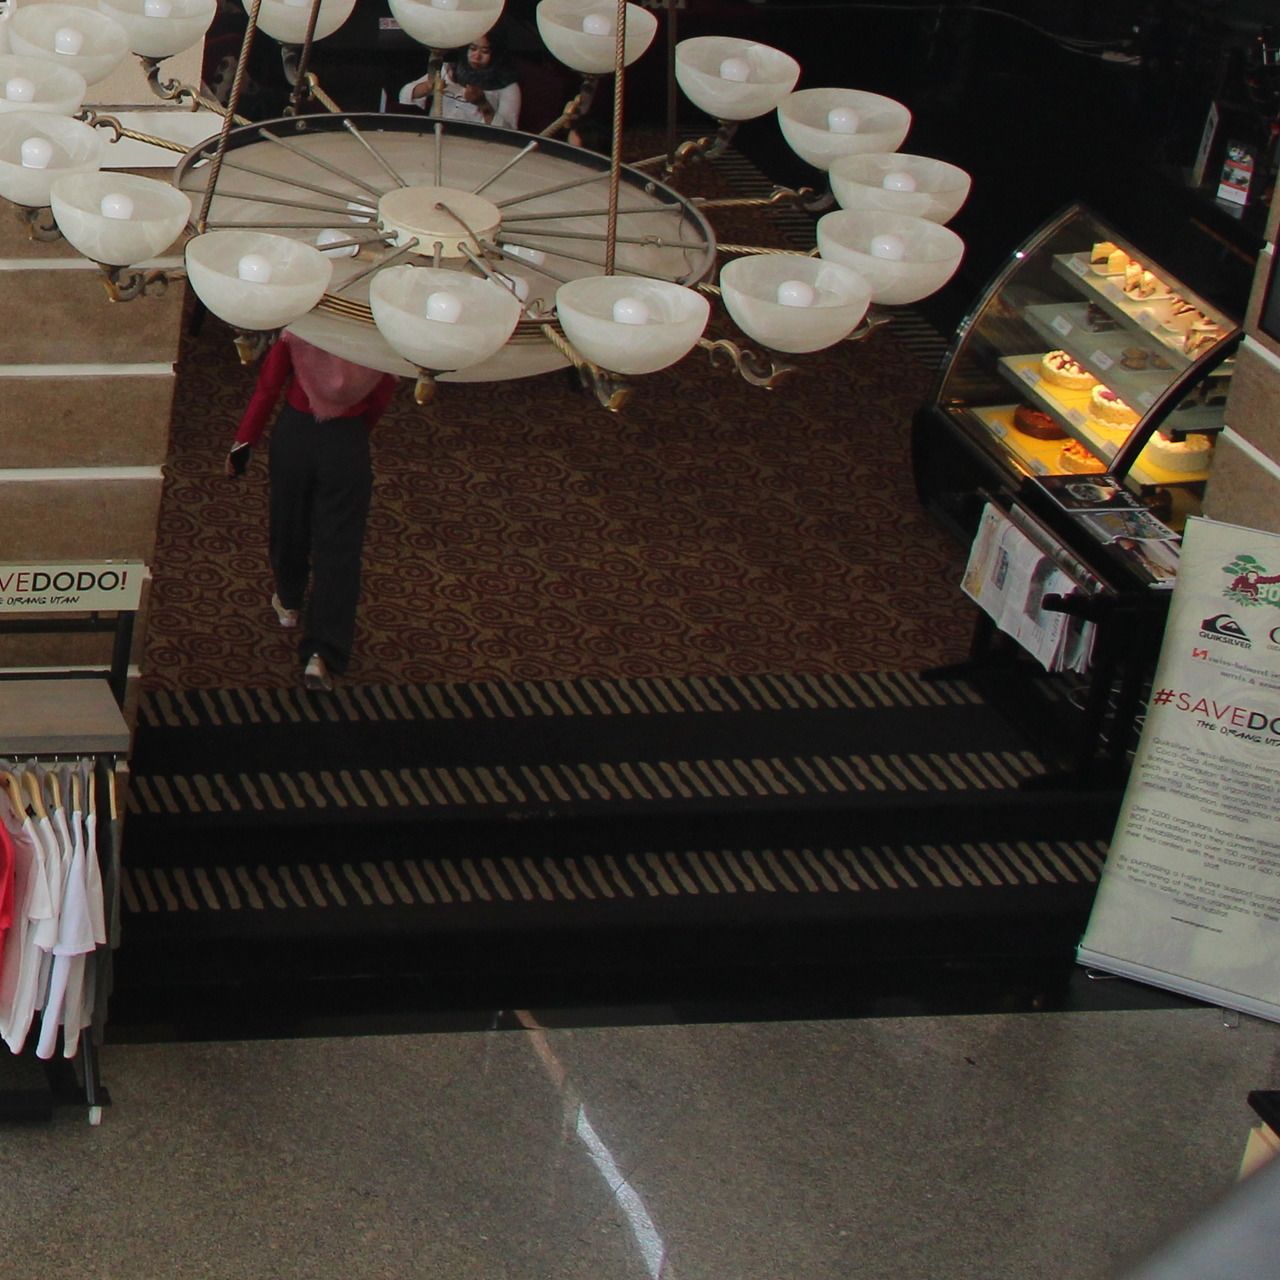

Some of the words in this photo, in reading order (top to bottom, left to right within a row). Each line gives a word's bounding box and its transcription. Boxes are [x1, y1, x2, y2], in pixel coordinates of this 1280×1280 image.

[7, 597, 46, 606] ORANG
[50, 596, 80, 604] UTAN
[1199, 631, 1252, 649] QUIKSILVER
[1196, 720, 1217, 731] THE
[1220, 726, 1261, 742] ORANG
